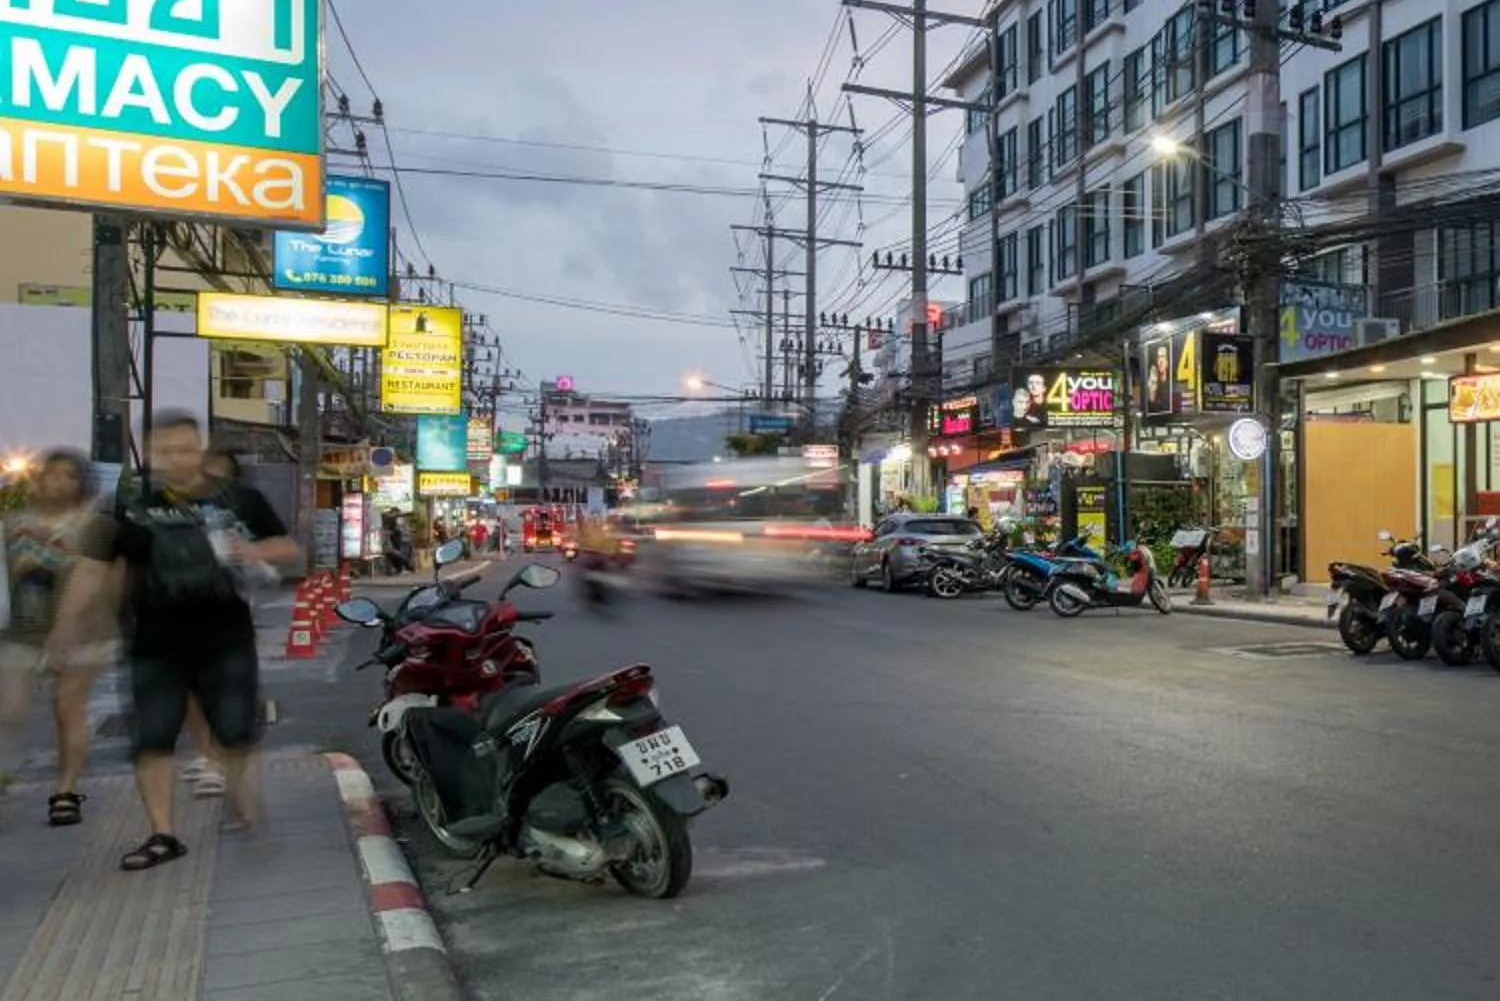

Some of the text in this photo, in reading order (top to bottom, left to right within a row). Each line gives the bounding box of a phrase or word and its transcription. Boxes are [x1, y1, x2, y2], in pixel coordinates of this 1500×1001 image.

[11, 37, 304, 137] MACY
[1303, 309, 1352, 330] you
[1067, 376, 1112, 393] you
[1071, 390, 1113, 410] OPTIC
